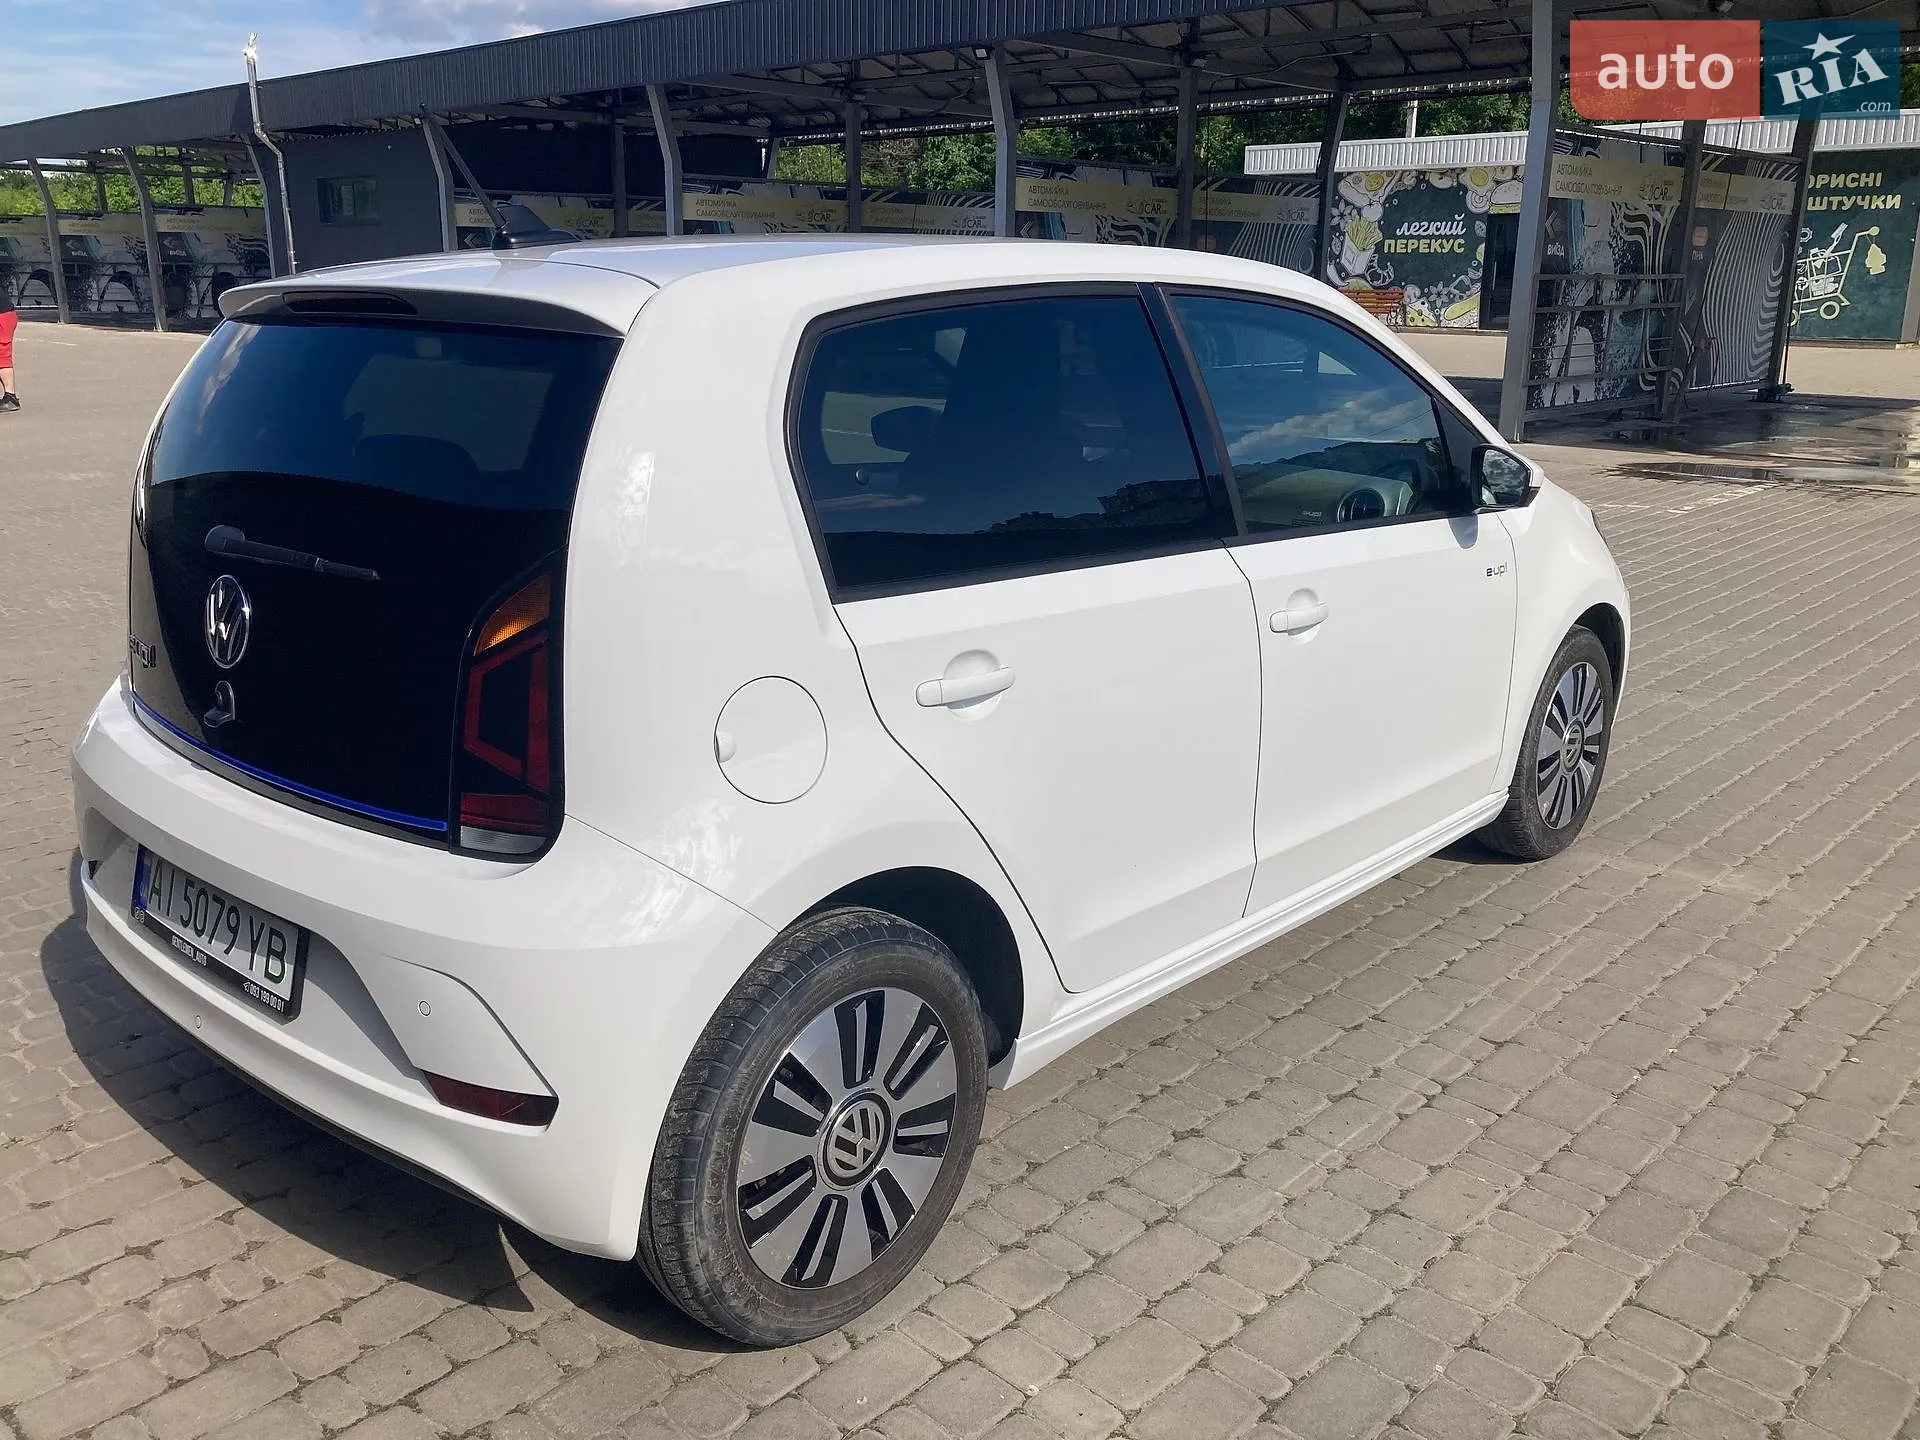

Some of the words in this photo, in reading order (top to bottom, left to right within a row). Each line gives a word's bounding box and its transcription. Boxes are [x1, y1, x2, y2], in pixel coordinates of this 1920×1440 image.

[1028, 185, 1069, 195] АВТОМИЙКА
[1806, 194, 1902, 211] ШТУЧКИ
[1396, 213, 1466, 236] легкий
[1384, 239, 1465, 253] ПЕРЕКУС
[149, 857, 175, 917] AI
[180, 878, 241, 955] 5079
[249, 916, 287, 984] YB
